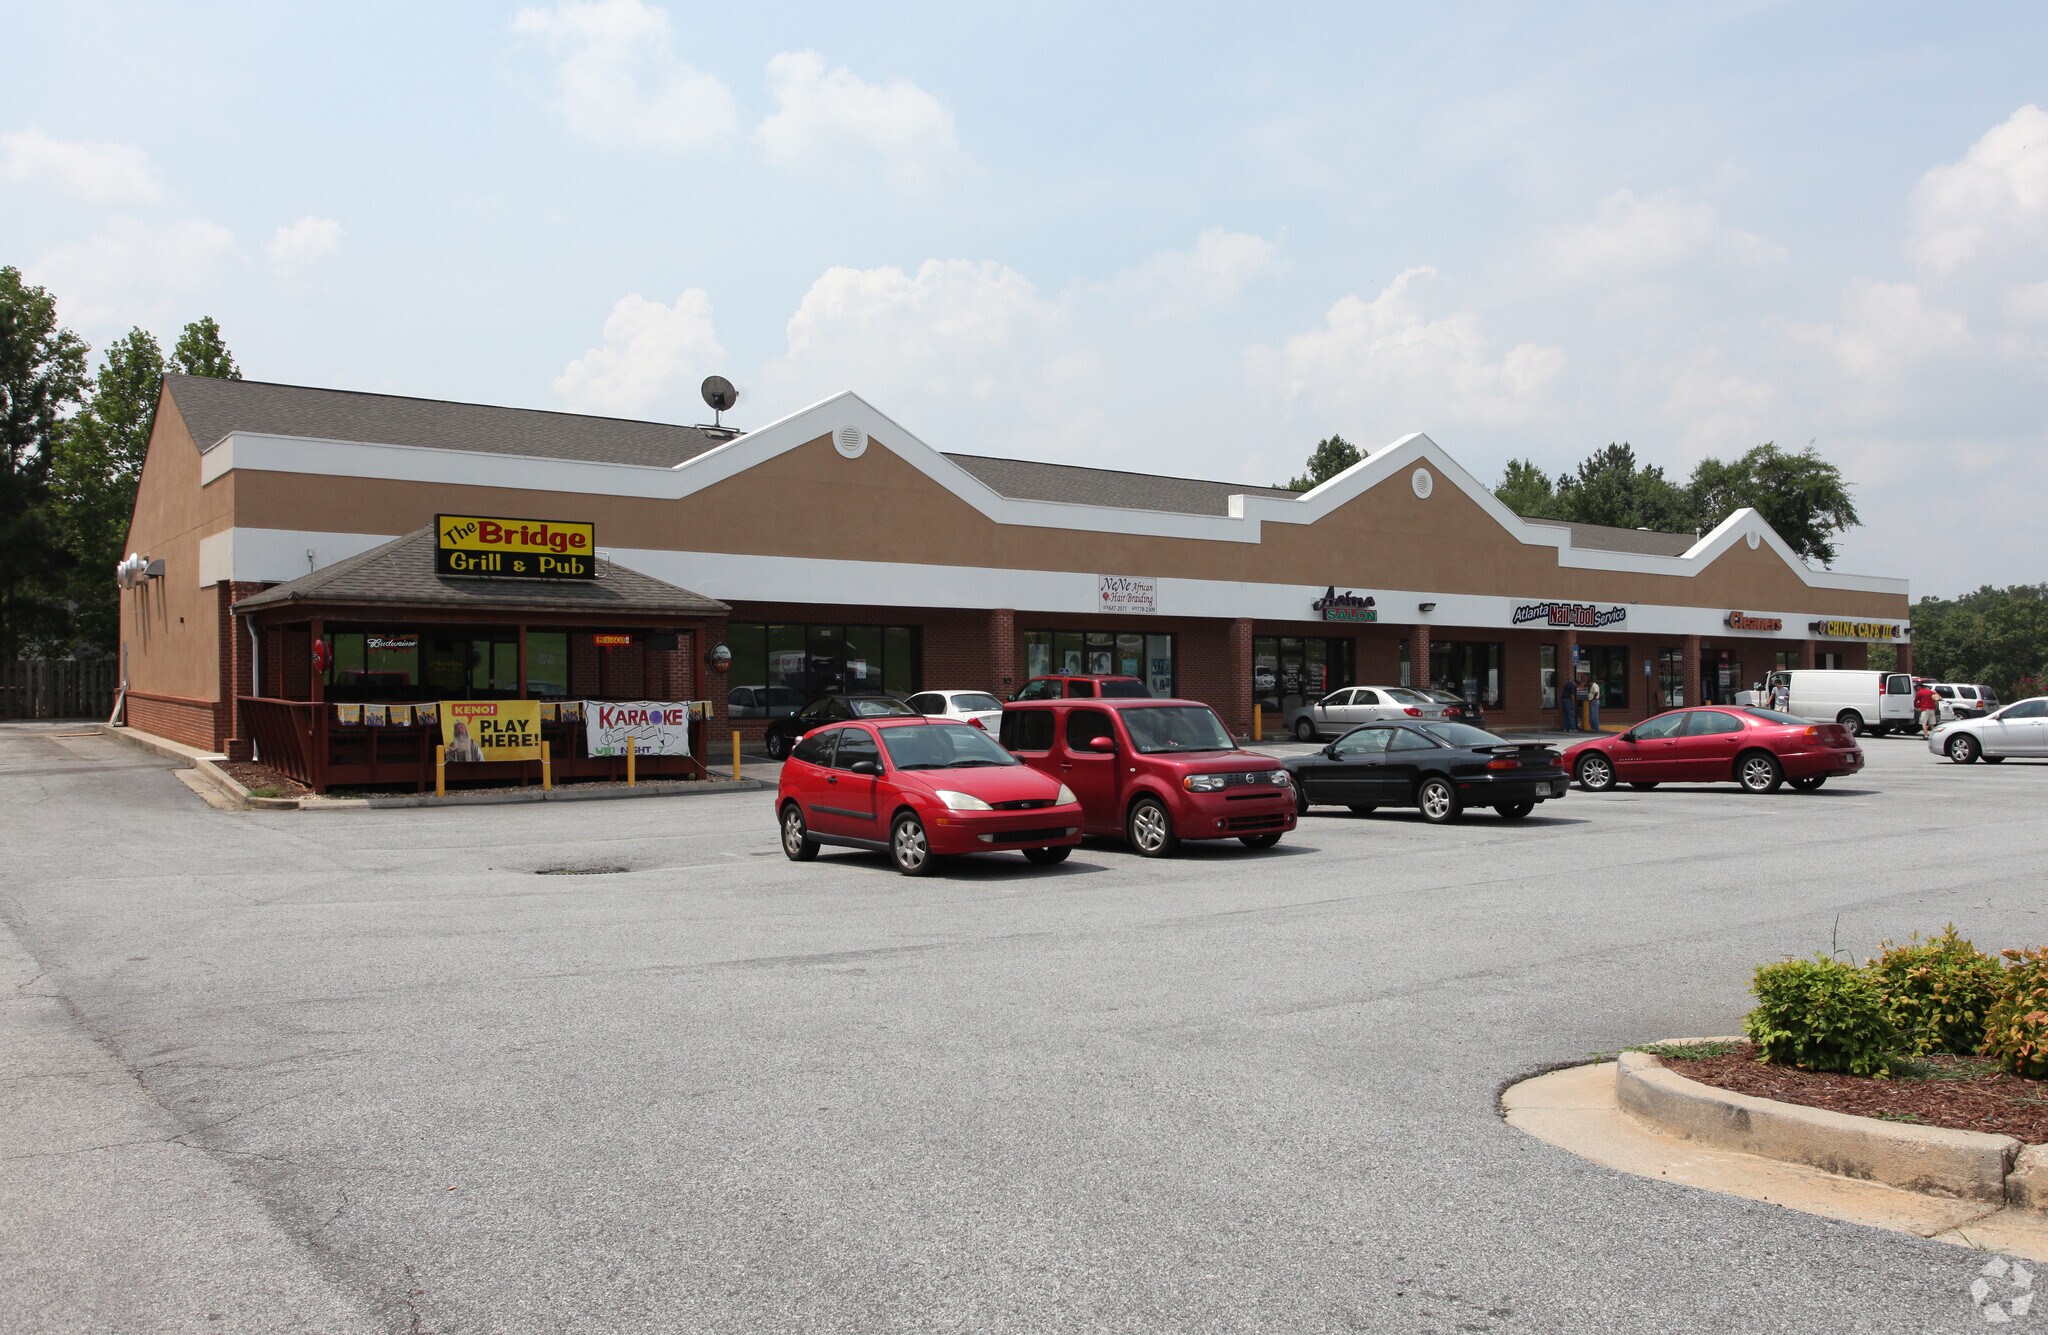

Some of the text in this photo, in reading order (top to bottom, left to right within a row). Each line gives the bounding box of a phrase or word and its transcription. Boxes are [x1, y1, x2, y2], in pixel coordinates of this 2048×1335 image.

[444, 521, 586, 553] The Bridge
[450, 552, 584, 575] Grill & Pub
[1101, 577, 1153, 593] NeNe African
[1110, 592, 1153, 606] Hair Braiding
[1327, 609, 1377, 622] SALON
[1513, 603, 1549, 624] Atlanta
[1549, 604, 1570, 625] Nail
[1573, 604, 1595, 626] Tool
[1594, 607, 1626, 627] Service
[1730, 611, 1782, 631] Cleaners
[1827, 621, 1893, 638] CHINA CAFE III
[367, 638, 418, 648] Budweiser
[596, 636, 630, 644] KENO!
[454, 705, 495, 714] KENO!
[600, 706, 683, 729] KARAOKE
[480, 719, 529, 733] PLAY
[481, 733, 539, 748] HERE!
[620, 746, 651, 754] NGHT
